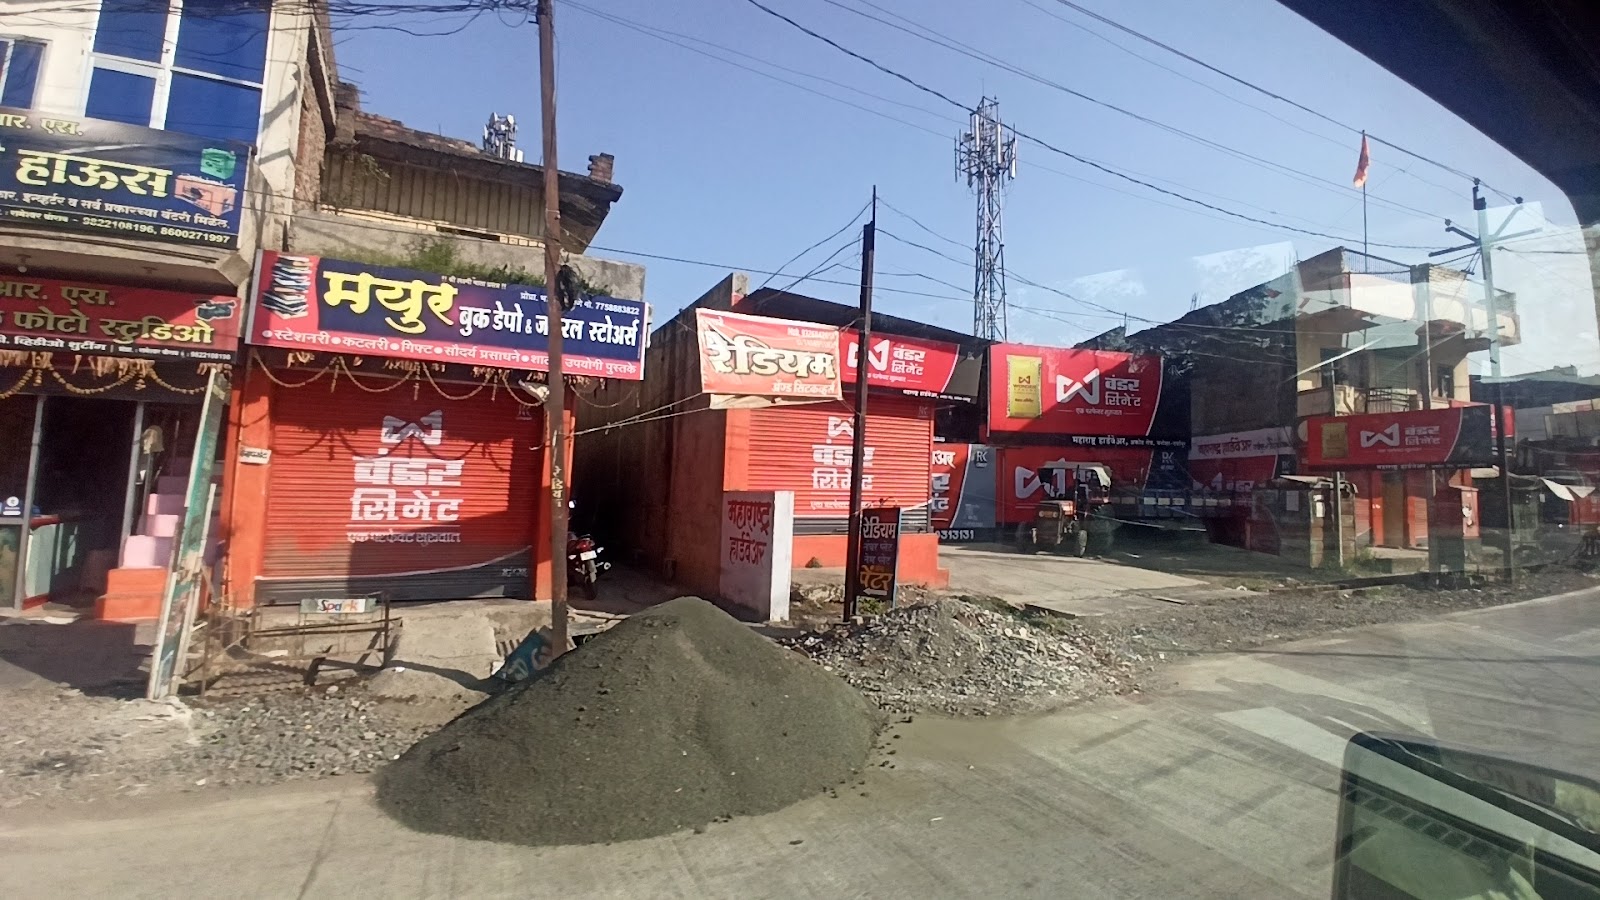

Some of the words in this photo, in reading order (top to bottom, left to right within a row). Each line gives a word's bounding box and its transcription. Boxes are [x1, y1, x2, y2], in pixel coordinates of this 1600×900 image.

[41, 118, 83, 136] एस.
[16, 149, 172, 198] हाऊस
[68, 198, 78, 207] व
[161, 227, 230, 243] 8600271997
[60, 286, 115, 305] एस.
[323, 271, 458, 334] मयुर
[13, 306, 90, 335] फोटो
[99, 316, 215, 345] स्टुडिओ
[459, 305, 491, 340] बुक
[493, 300, 524, 336] डेपो
[525, 318, 534, 335] &
[535, 314, 585, 341] जरल
[589, 315, 640, 346] स्टोअर्स
[275, 328, 330, 346] स्टेशनरी
[342, 336, 390, 351] कटलरी
[401, 341, 433, 355] गिफ्ट
[479, 349, 520, 363] प्रसाधने
[565, 357, 603, 371] उपयोगी
[605, 362, 637, 375] पुस्तके
[705, 326, 837, 380] रेडियम
[893, 345, 926, 363] वंडर
[891, 361, 924, 375] सिमेंट
[1105, 374, 1140, 392] वंडर
[1105, 391, 1141, 407] सिमेंट
[353, 447, 465, 486] वंडर
[350, 488, 463, 521] सिमेंट
[862, 516, 897, 539] रेडियम
